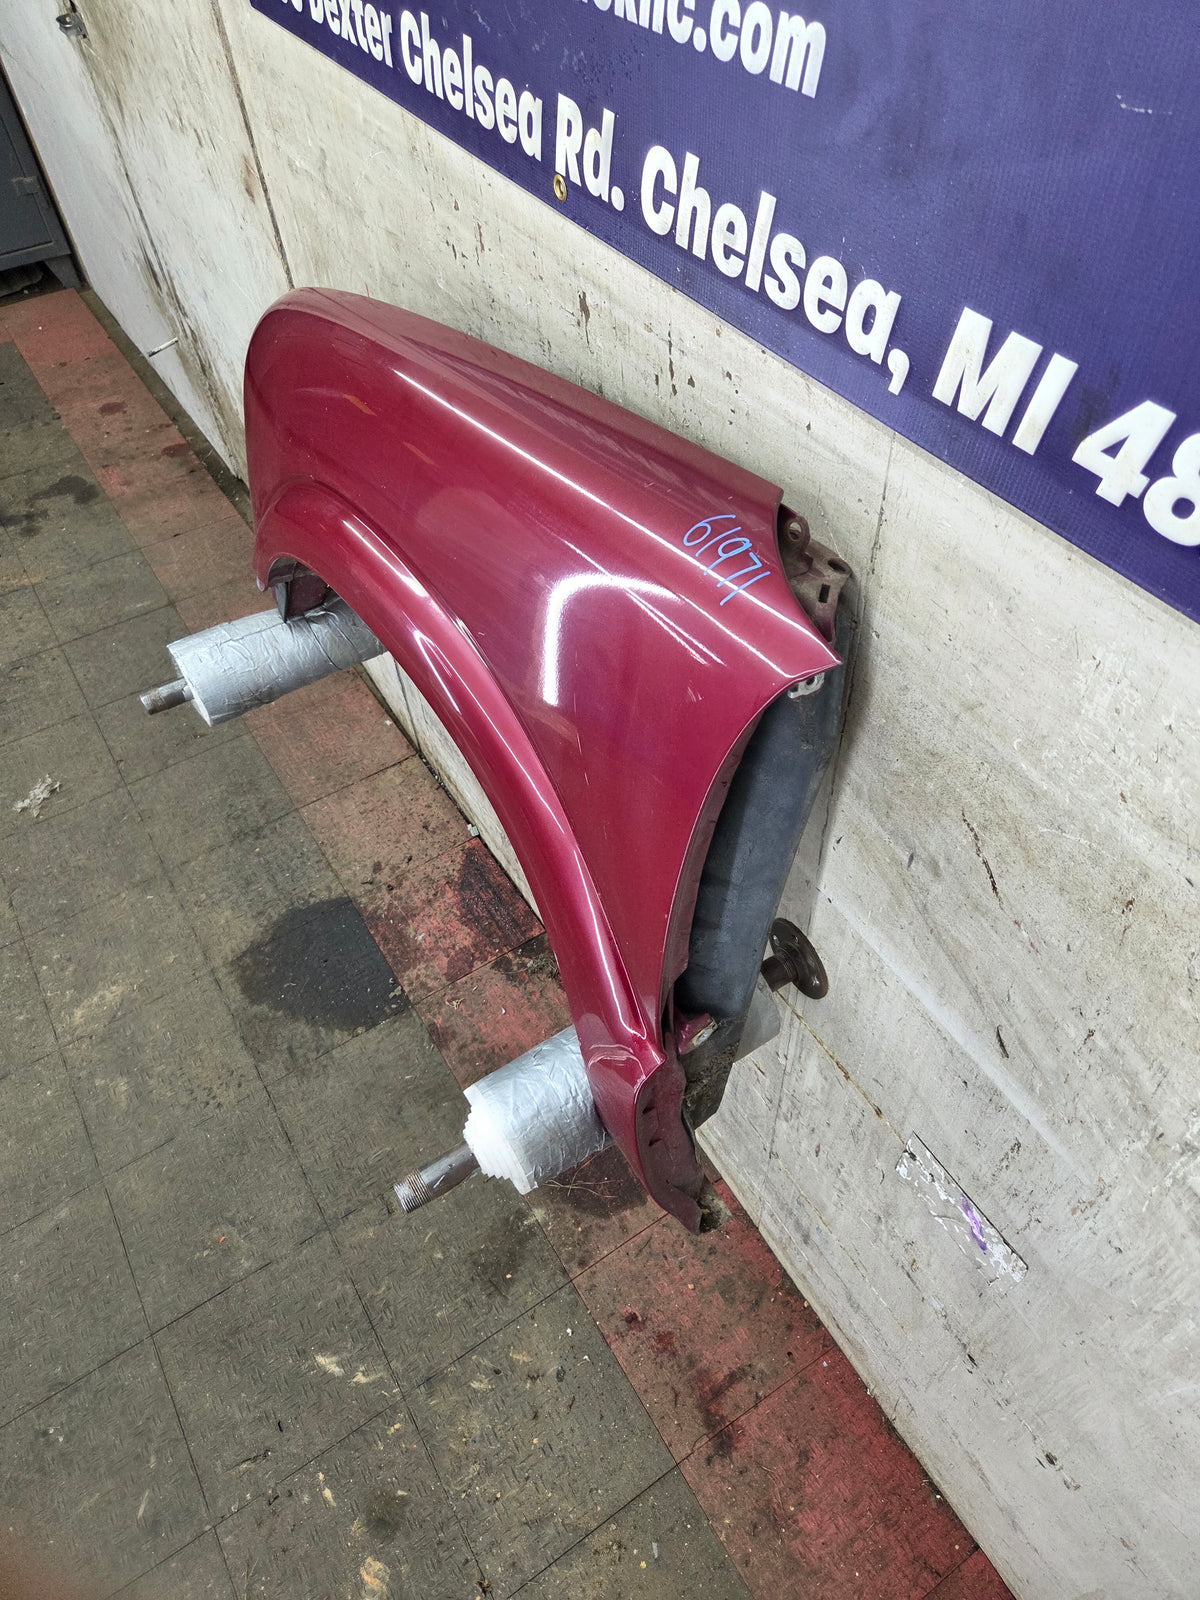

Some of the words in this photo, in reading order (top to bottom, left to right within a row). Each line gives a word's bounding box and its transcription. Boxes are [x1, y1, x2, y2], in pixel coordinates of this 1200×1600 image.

[400, 9, 543, 162] Chelsea
[554, 92, 625, 212] Rd.
[640, 144, 910, 396] Chelsea,
[931, 305, 1079, 456] MI
[682, 513, 771, 607] 61971
